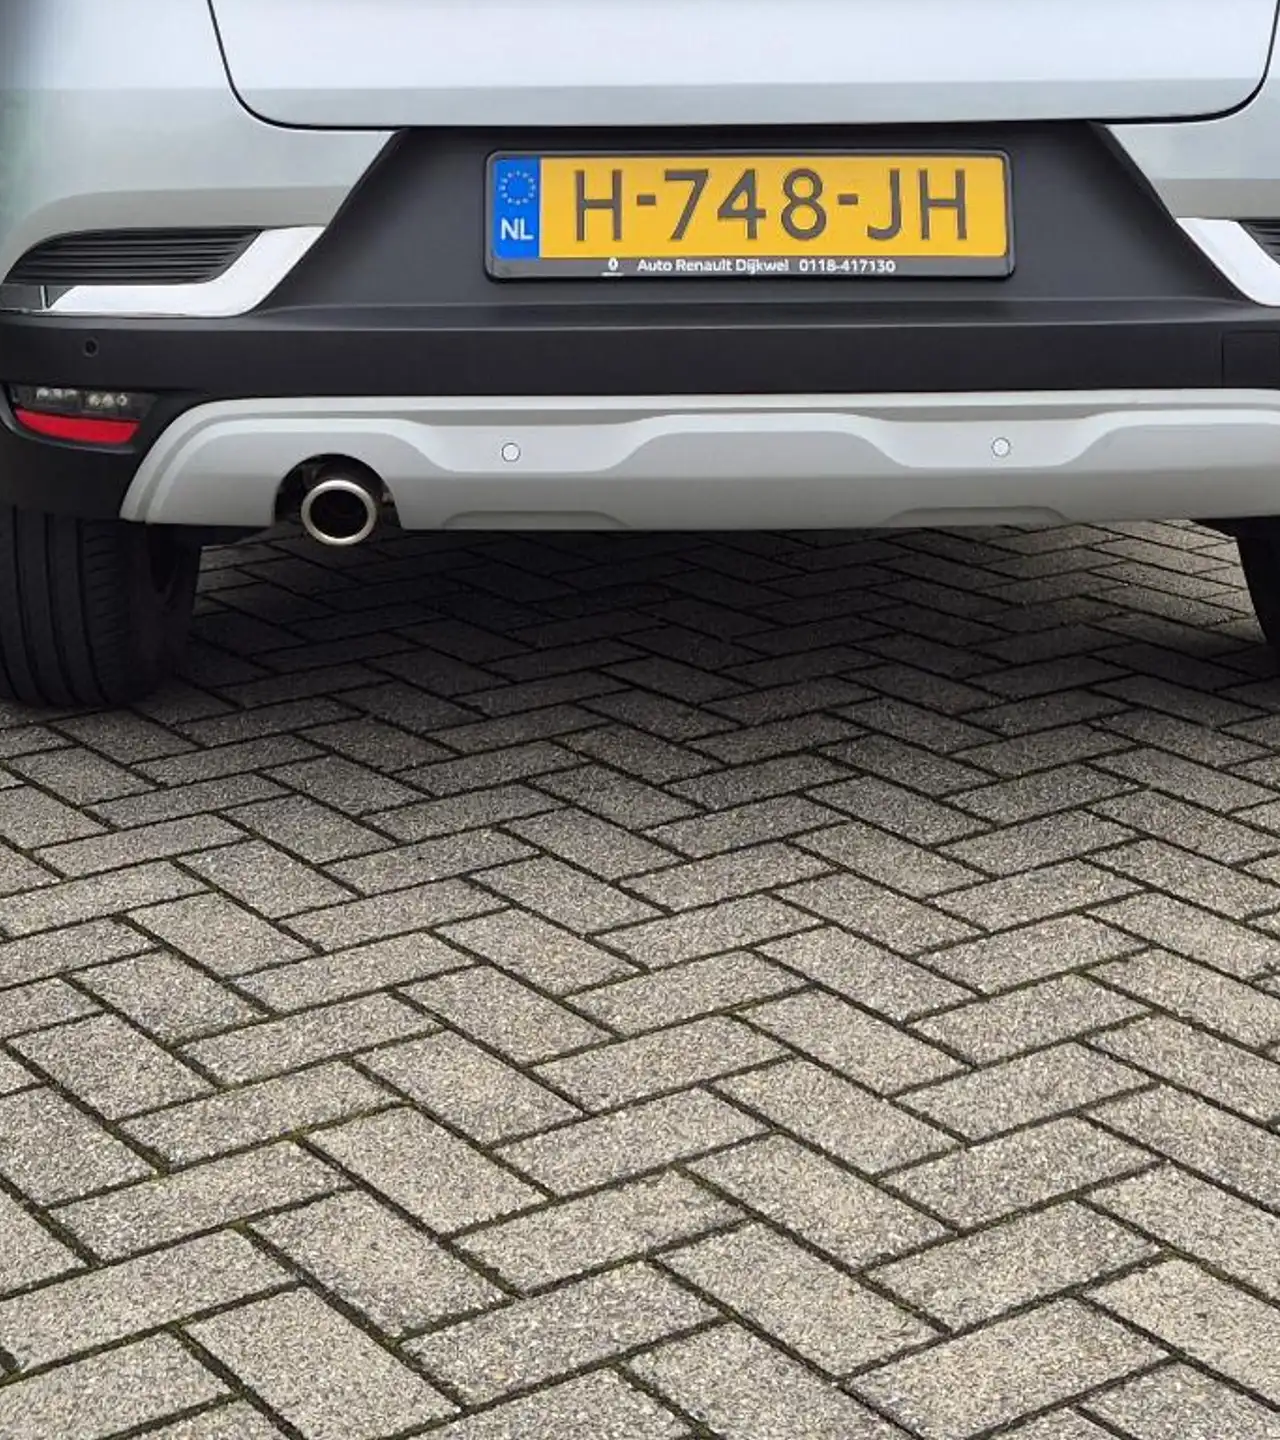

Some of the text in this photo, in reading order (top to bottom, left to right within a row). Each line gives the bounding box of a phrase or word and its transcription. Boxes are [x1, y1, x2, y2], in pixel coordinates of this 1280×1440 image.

[574, 168, 968, 242] H-748-JH
[500, 218, 534, 242] NL
[636, 258, 897, 275] Auto Renault Dijkwel 0118-417130
